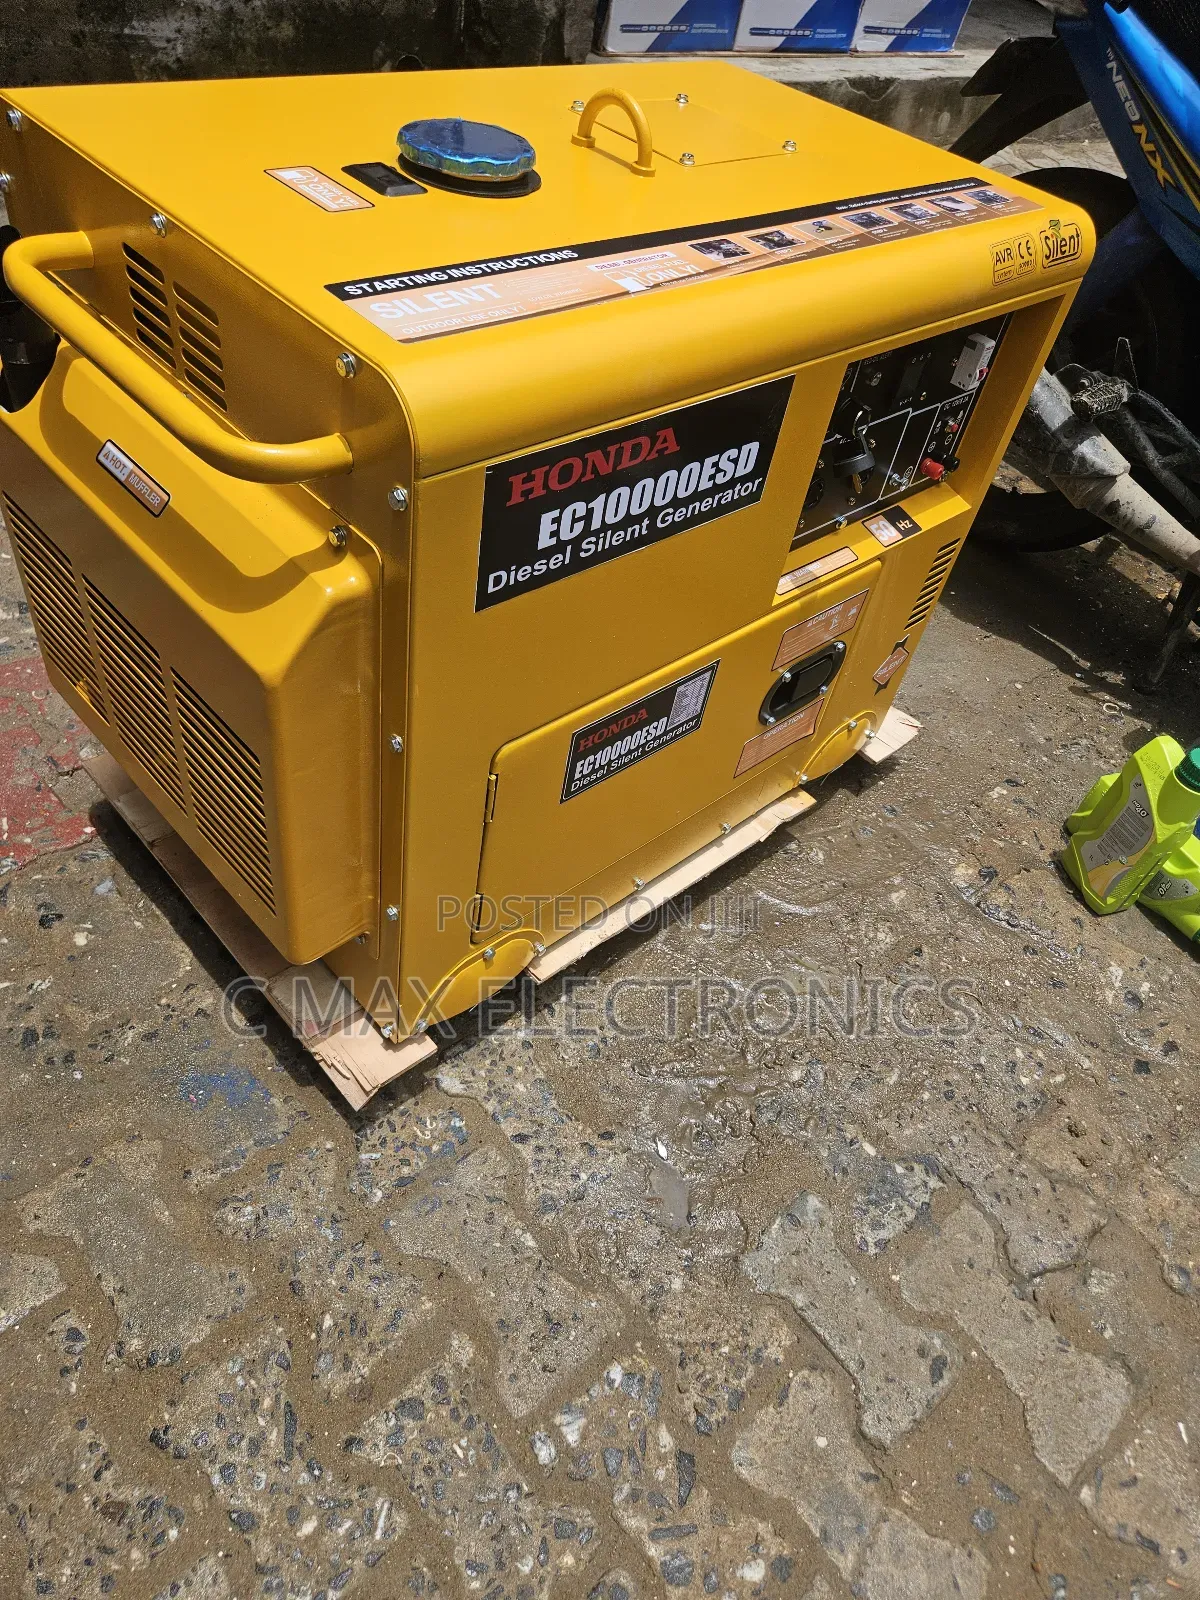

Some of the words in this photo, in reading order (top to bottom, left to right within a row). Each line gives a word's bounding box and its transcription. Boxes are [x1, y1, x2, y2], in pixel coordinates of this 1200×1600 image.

[1106, 61, 1141, 122] NEO
[1131, 123, 1179, 190] NX
[995, 247, 1014, 266] AVR
[1044, 227, 1080, 261] Silent
[343, 270, 449, 296] STARTING
[447, 249, 579, 278] INSTRUCTIONS
[369, 282, 503, 320] SILENT
[402, 317, 465, 335] OUTDOOR
[465, 313, 488, 326] USE
[128, 473, 161, 507] MUFFLER
[505, 427, 681, 507] HONDA
[537, 441, 760, 551] EC10000ESD
[487, 544, 571, 594] Diesel
[579, 518, 651, 558] Silent
[656, 477, 763, 529] Generator
[870, 520, 897, 541] 50
[895, 519, 914, 531] Hz
[573, 716, 668, 781] EC10000ESD
[577, 708, 649, 753] HONDA
[570, 765, 608, 792] Diesel
[610, 747, 643, 771] Silent
[645, 718, 698, 752] Generator
